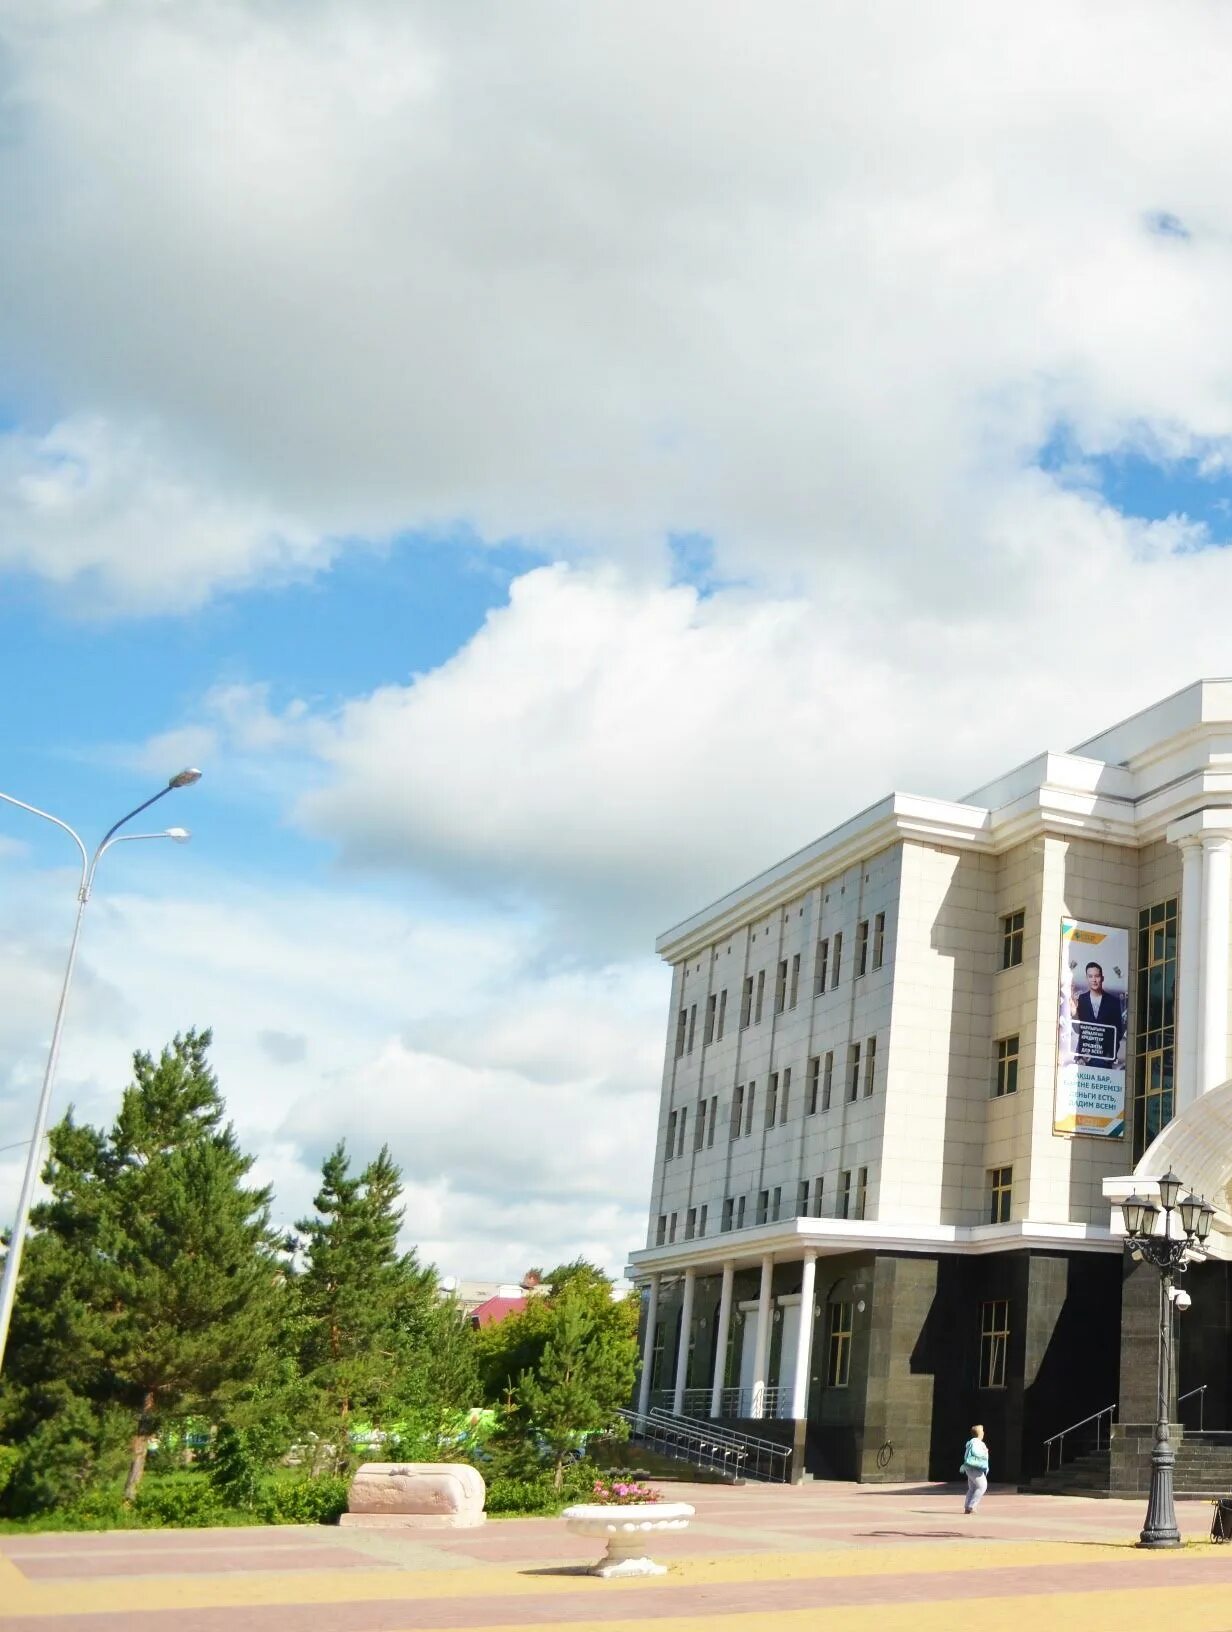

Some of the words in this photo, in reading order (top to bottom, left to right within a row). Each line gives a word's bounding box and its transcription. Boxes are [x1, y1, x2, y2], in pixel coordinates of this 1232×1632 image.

[1097, 1074, 1112, 1084] БАР,
[1097, 1094, 1117, 1103] ЕСТЬ,
[1095, 1102, 1117, 1111] ВСЕМ!
